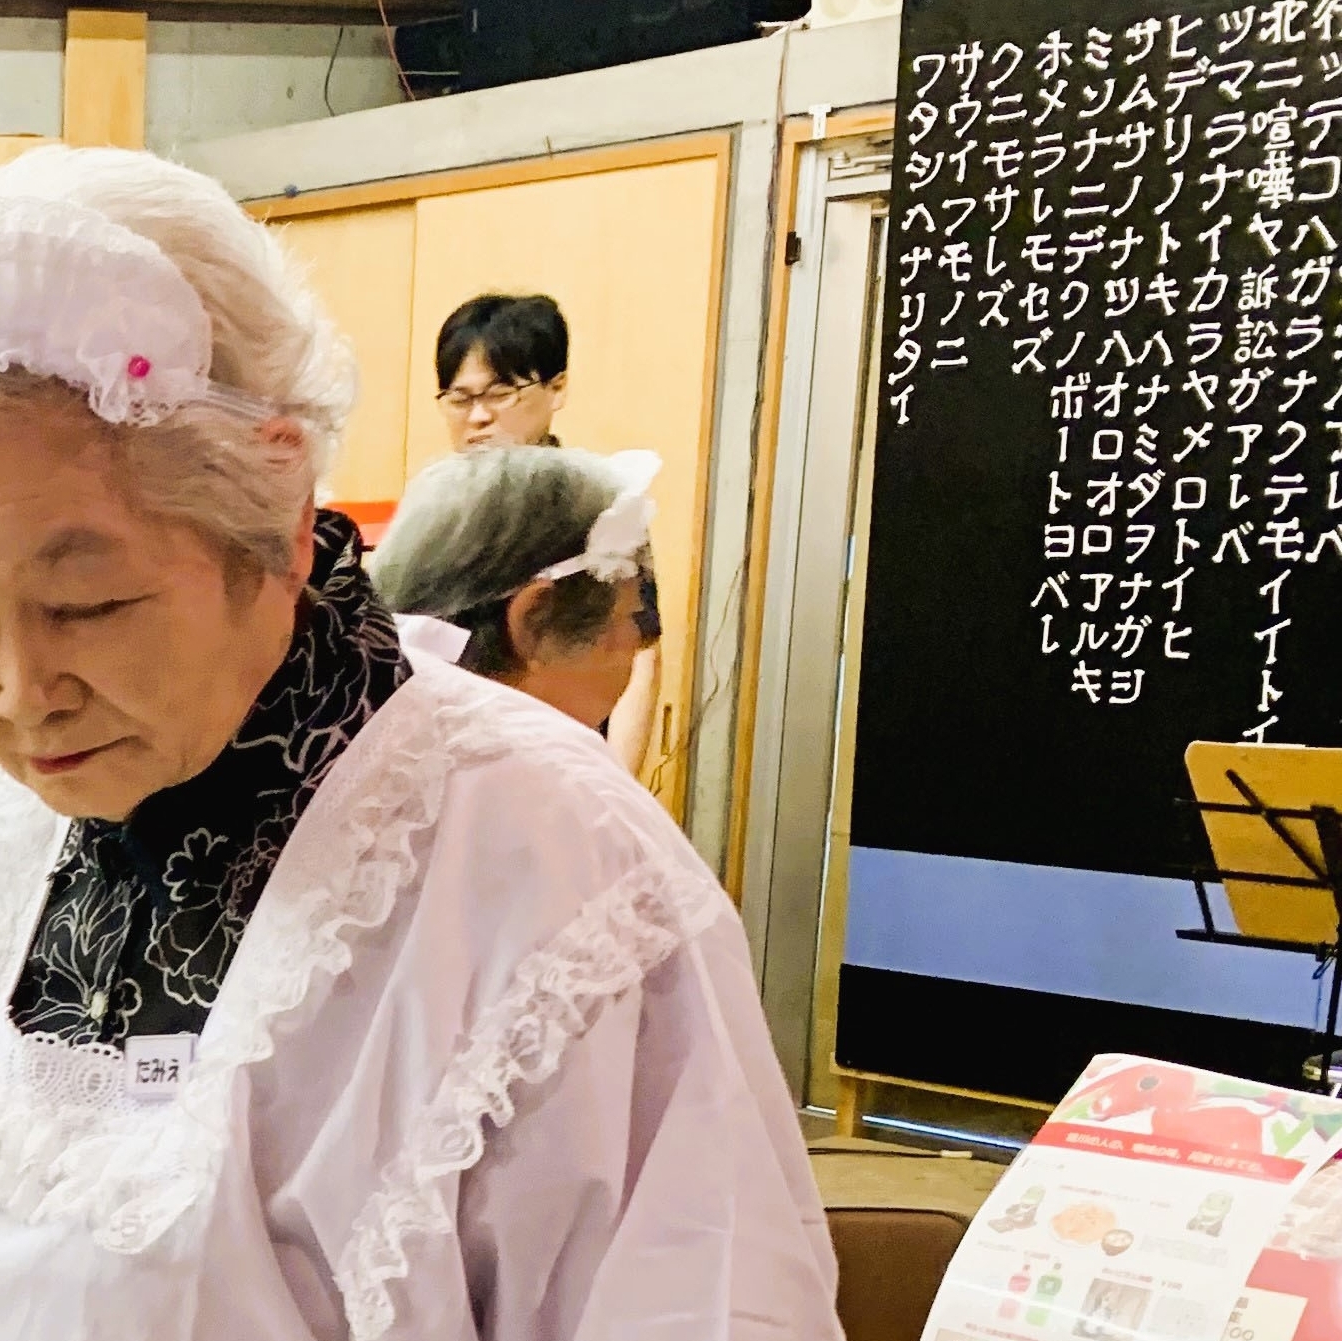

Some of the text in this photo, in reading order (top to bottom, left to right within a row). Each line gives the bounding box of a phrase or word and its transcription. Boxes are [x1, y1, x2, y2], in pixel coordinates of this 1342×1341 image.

[888, 53, 945, 424] ワタシハナリタイ
[930, 41, 983, 369] サウイフモノニ
[979, 42, 1027, 328] クニモサレズ
[1012, 29, 1074, 373] ホメラレモセズ
[1070, 17, 1160, 703] サムサノナツハオロオロアルキ
[1110, 14, 1211, 704] ヒデリノトキハナミダヲナガシ
[1162, 5, 1256, 659] ツマラナイカラヤメロトイヒ
